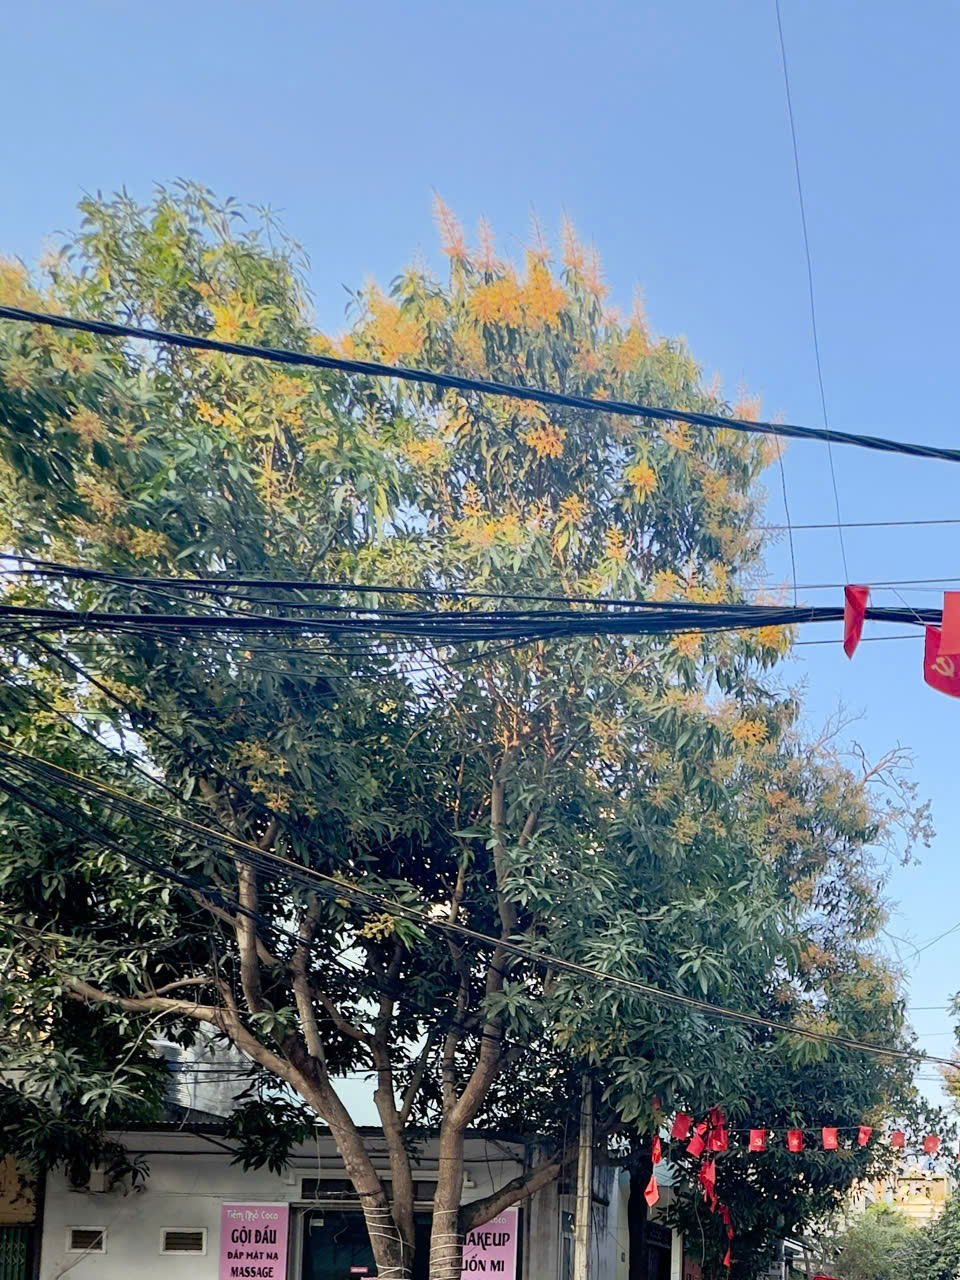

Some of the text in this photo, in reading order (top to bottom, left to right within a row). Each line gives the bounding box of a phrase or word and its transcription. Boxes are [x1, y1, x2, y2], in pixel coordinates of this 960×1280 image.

[464, 1231, 511, 1251] AKEUP
[230, 1266, 274, 1278] MASSAGE
[490, 1259, 505, 1272] MI
